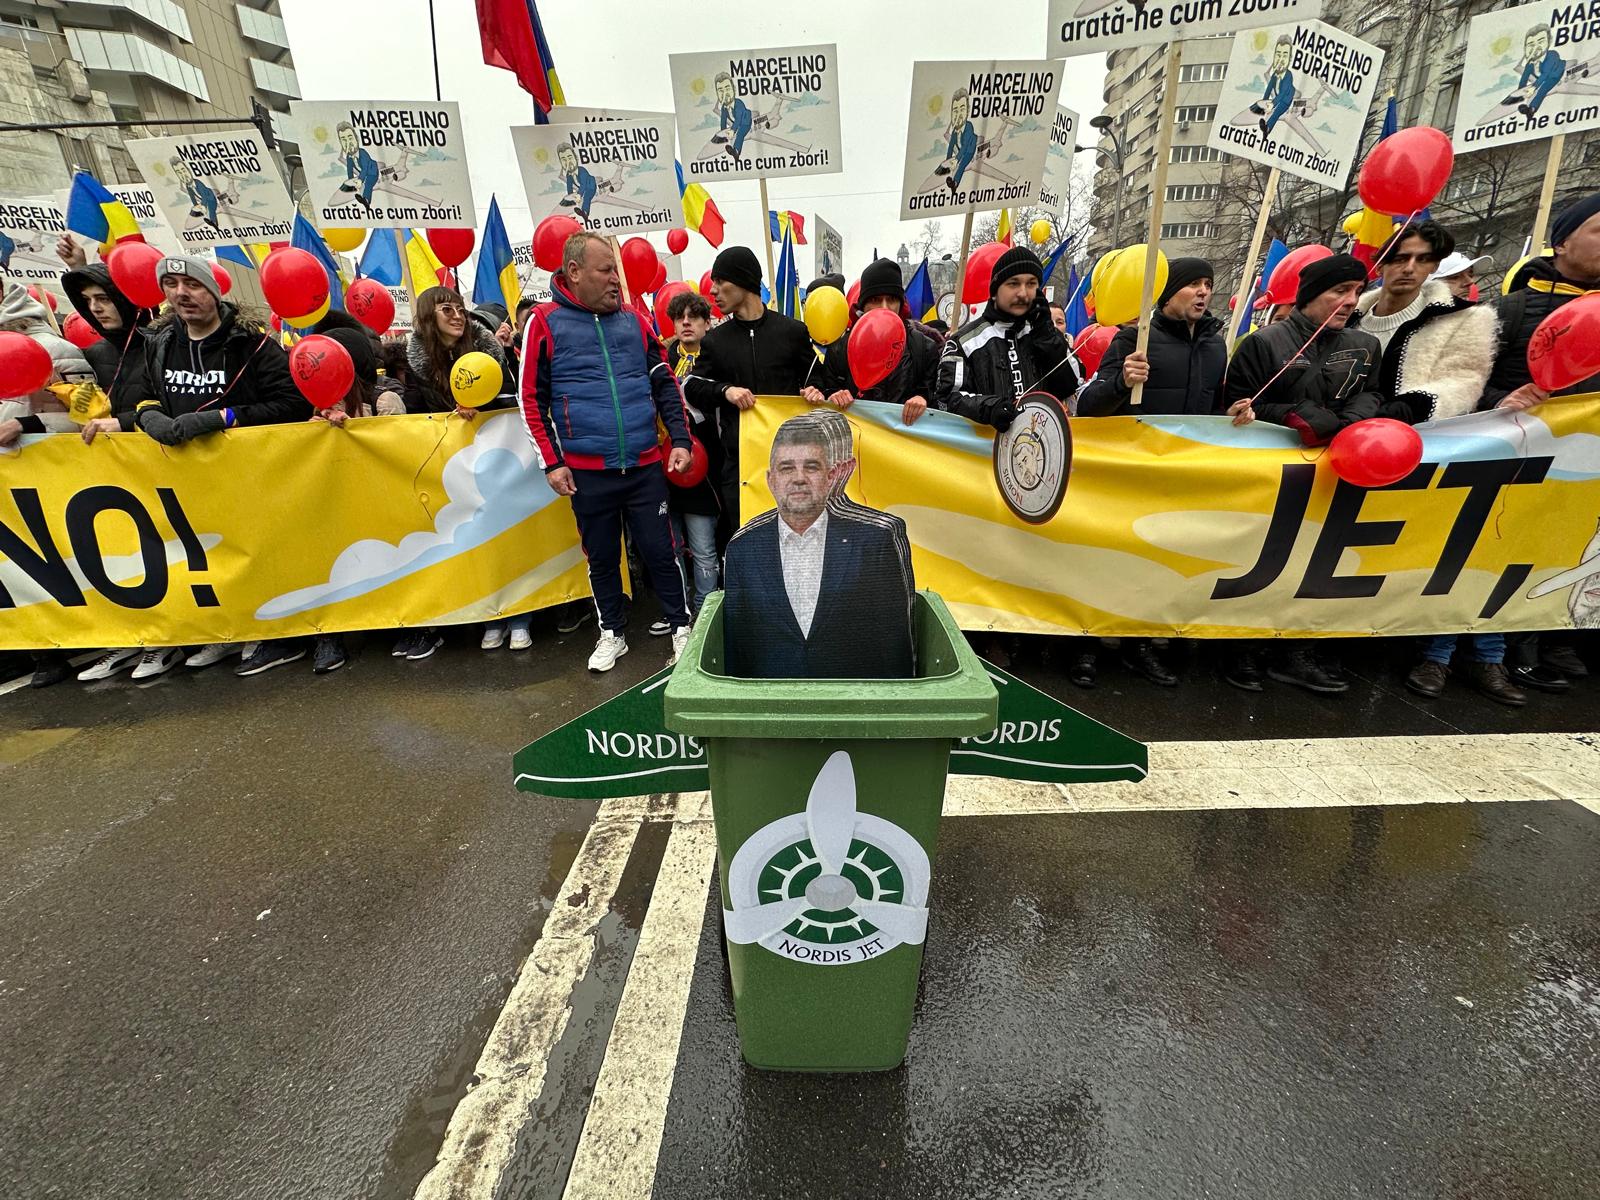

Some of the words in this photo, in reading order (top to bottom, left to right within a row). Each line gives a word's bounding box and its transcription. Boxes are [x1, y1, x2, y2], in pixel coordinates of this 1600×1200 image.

[1061, 8, 1163, 42] arată-ne
[1169, 0, 1222, 26] cum
[1292, 25, 1373, 76] MARCELINO
[729, 54, 826, 78] MARCELINO
[1291, 49, 1362, 94] BURATINO
[737, 73, 822, 96] BURATINO
[968, 72, 1054, 96] MARCELINO
[970, 95, 1045, 118] BURATINO
[350, 110, 450, 129] MARCELINO
[1053, 112, 1072, 132] INO
[1464, 114, 1549, 142] arată-ne
[1554, 105, 1598, 126] cum
[360, 129, 447, 147] BURATINO
[569, 127, 660, 148] MARCELINO
[175, 139, 259, 161] MARCELINO
[579, 143, 658, 164] BURATINO
[690, 155, 752, 174] arată-ne
[755, 156, 786, 171] cum
[789, 149, 829, 168] zbori!
[1219, 124, 1277, 155] arată-ne
[1278, 144, 1304, 168] cum
[1304, 152, 1340, 177] zbori!
[188, 156, 262, 177] BURATINO
[909, 188, 966, 210] arată-ne
[968, 189, 998, 204] cum
[997, 181, 1031, 201] zbori!
[1037, 188, 1059, 207] bori!
[322, 204, 384, 220] arată-ne
[387, 208, 418, 220] cum
[422, 204, 462, 220] zbori!
[603, 214, 633, 229] cum
[635, 209, 673, 225] zbori!
[182, 225, 231, 241] arată-ne
[233, 225, 259, 239] cum
[260, 220, 293, 236] zbori!
[26, 269, 58, 279] cum
[1209, 455, 1555, 619] JET,
[585, 728, 704, 759] NORDIS
[779, 939, 852, 963] NORDIS
[857, 937, 885, 959] JET
